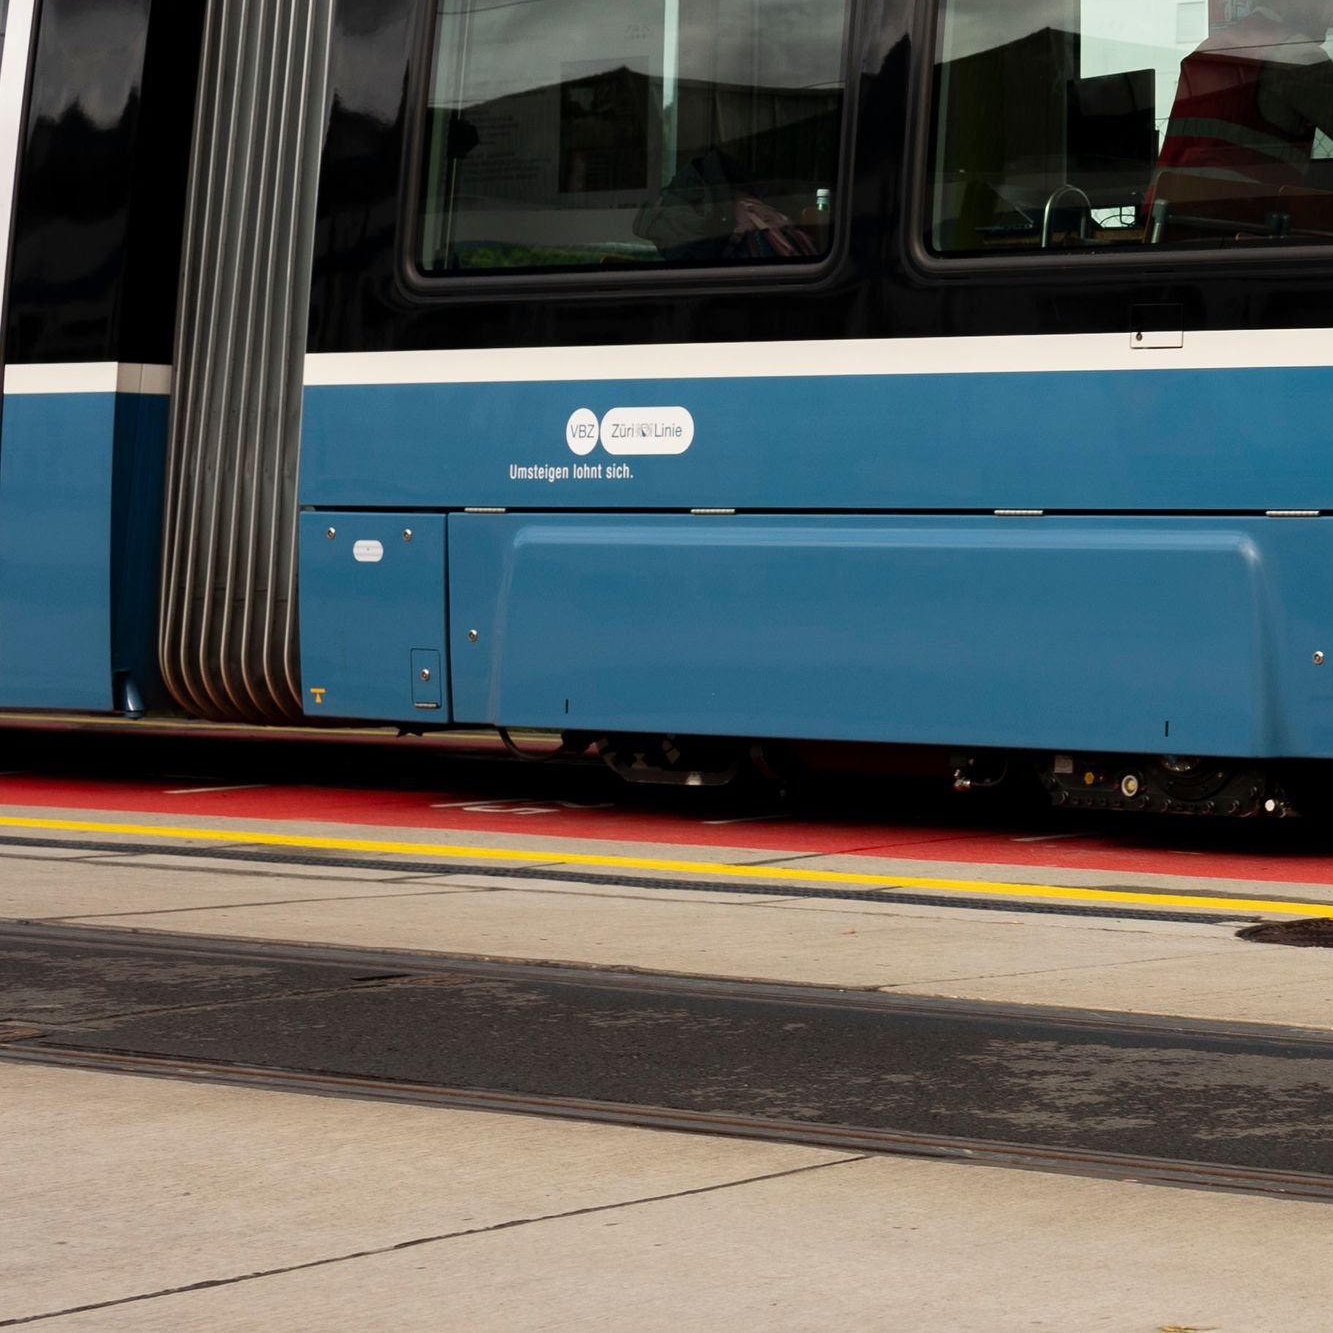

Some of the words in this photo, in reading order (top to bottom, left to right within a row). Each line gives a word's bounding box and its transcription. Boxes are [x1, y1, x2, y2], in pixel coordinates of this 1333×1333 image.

[570, 424, 595, 438] VBZ
[611, 423, 634, 438] Züri
[654, 423, 683, 437] Linie
[509, 463, 569, 482] Umsteigen
[573, 463, 602, 479] lohnt
[606, 463, 634, 479] sich.
